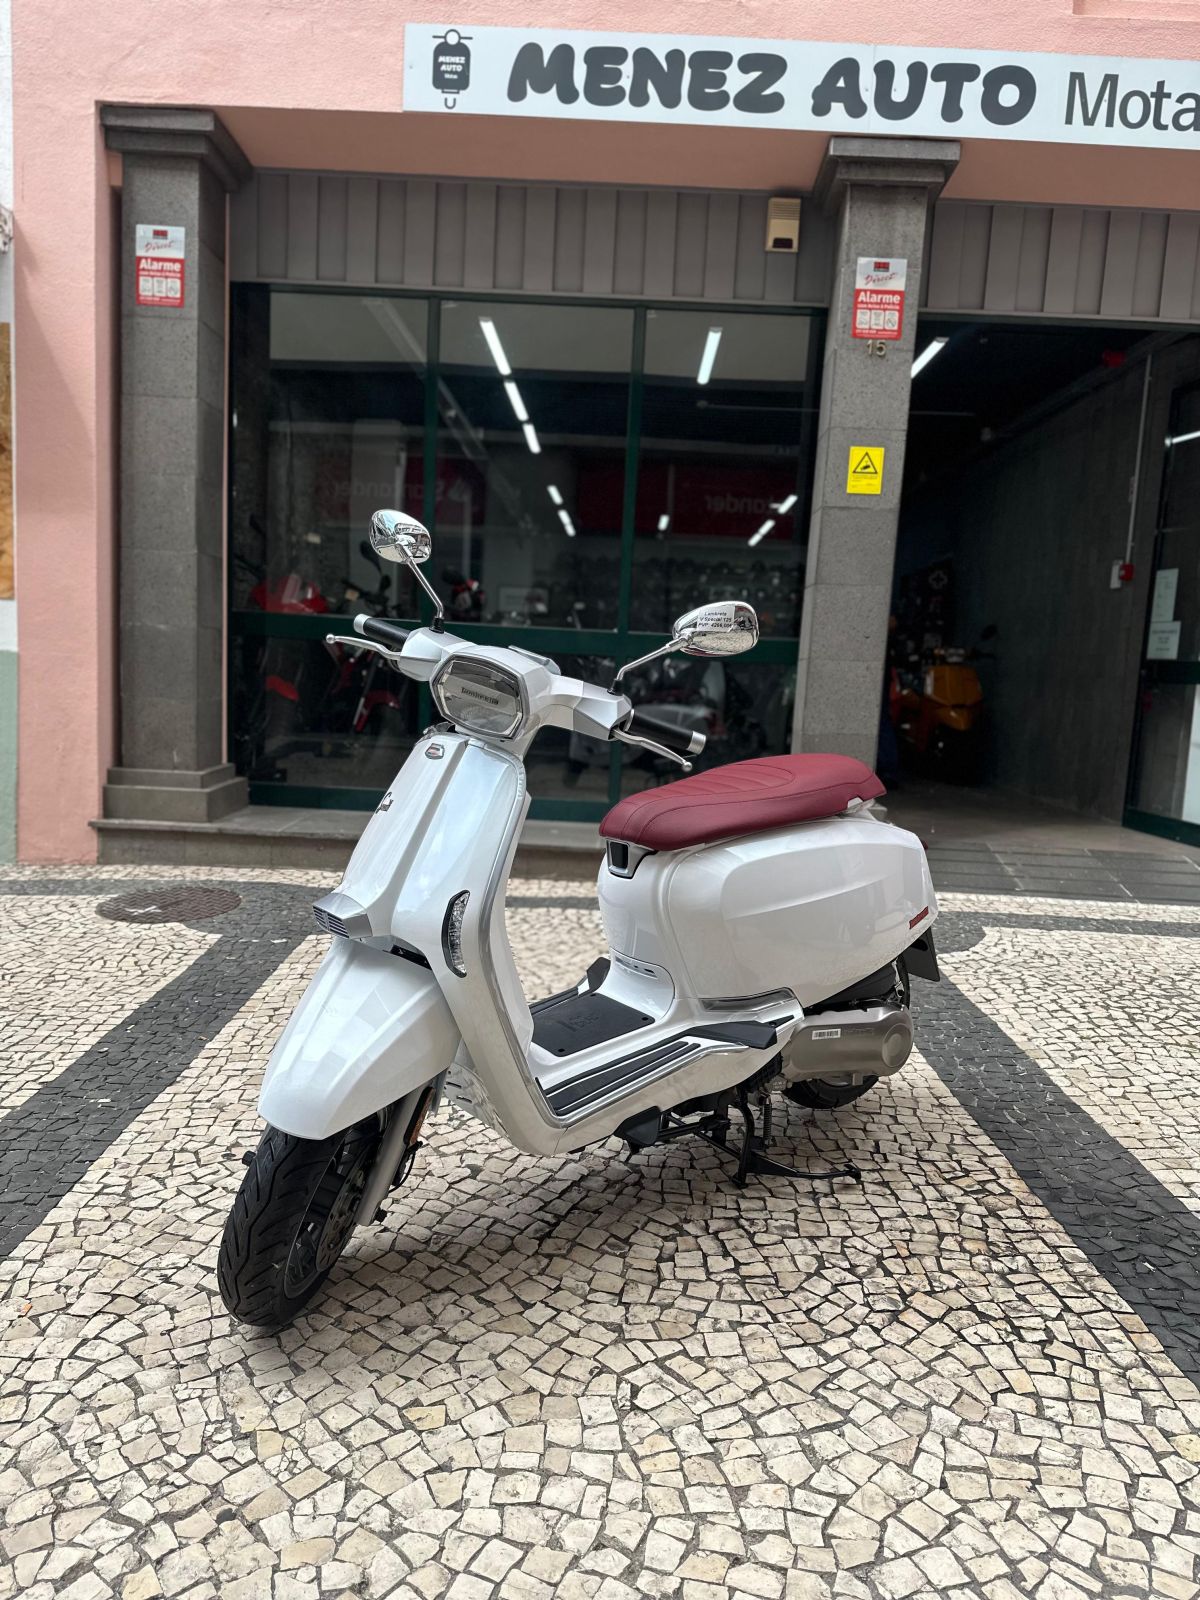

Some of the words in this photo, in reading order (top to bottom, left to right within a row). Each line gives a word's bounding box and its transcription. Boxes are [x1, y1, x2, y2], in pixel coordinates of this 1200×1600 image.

[508, 42, 788, 113] MENEZ
[812, 57, 1037, 126] AUTO
[1064, 72, 1200, 131] Mota
[140, 258, 182, 271] Alarme
[858, 291, 901, 304] Alarme
[867, 340, 886, 356] 15
